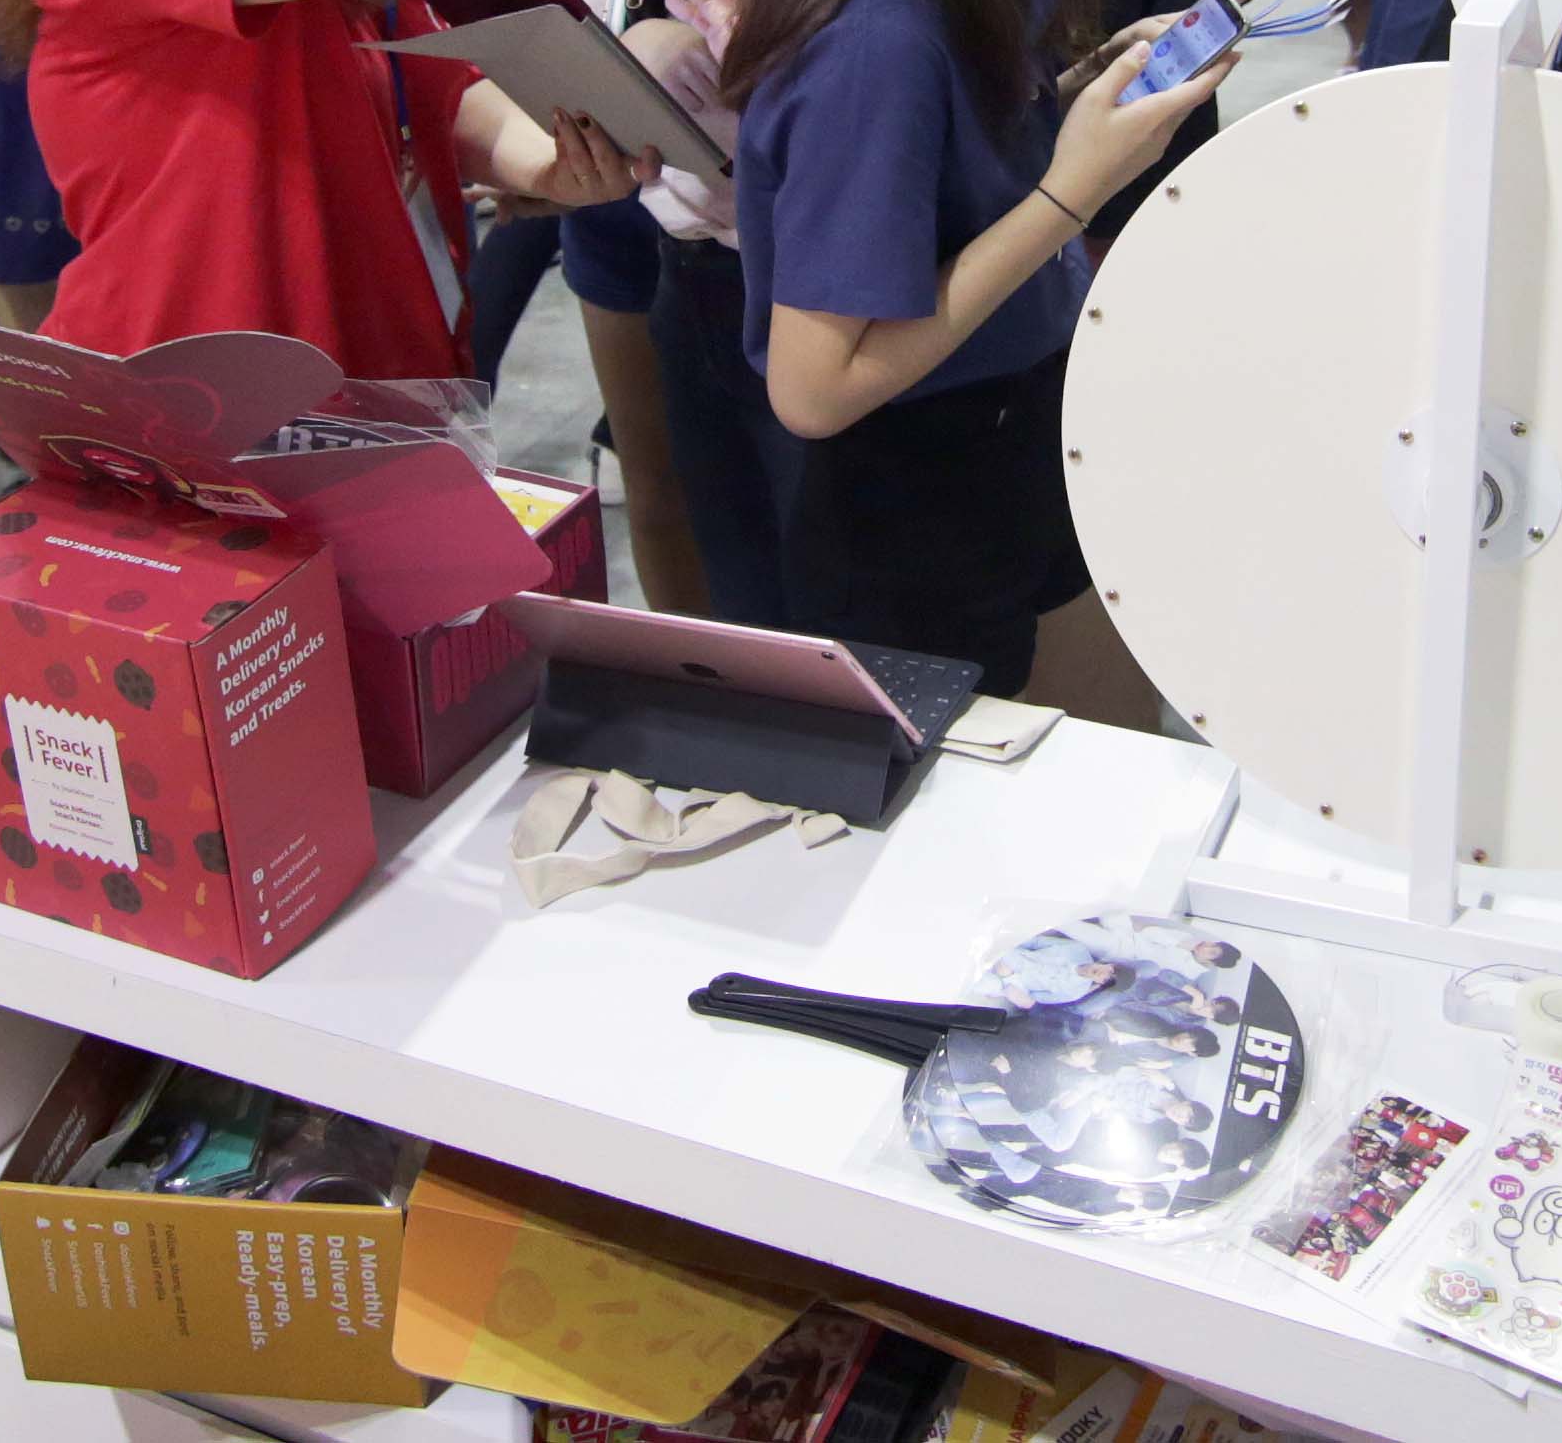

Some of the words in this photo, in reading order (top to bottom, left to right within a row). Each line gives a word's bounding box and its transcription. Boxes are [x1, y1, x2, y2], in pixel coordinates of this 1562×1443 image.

[44, 534, 183, 575] www.snackfever.com
[217, 652, 228, 671] A
[229, 605, 288, 661] Monthly
[220, 640, 281, 696] Delivery
[283, 622, 297, 647] of
[224, 673, 278, 722] Korean
[278, 632, 325, 680] Snacks
[230, 711, 259, 747] and
[259, 678, 307, 721] Treats.
[35, 729, 94, 760] Snack
[1233, 1025, 1293, 1121] BTS
[296, 1233, 318, 1300] Korean
[327, 1235, 350, 1313] Delivery
[357, 1235, 376, 1249] A
[236, 1229, 269, 1351] Ready-meals.
[265, 1231, 292, 1329] Easy-prep,
[359, 1253, 385, 1329] Monthly
[337, 1315, 358, 1336] of
